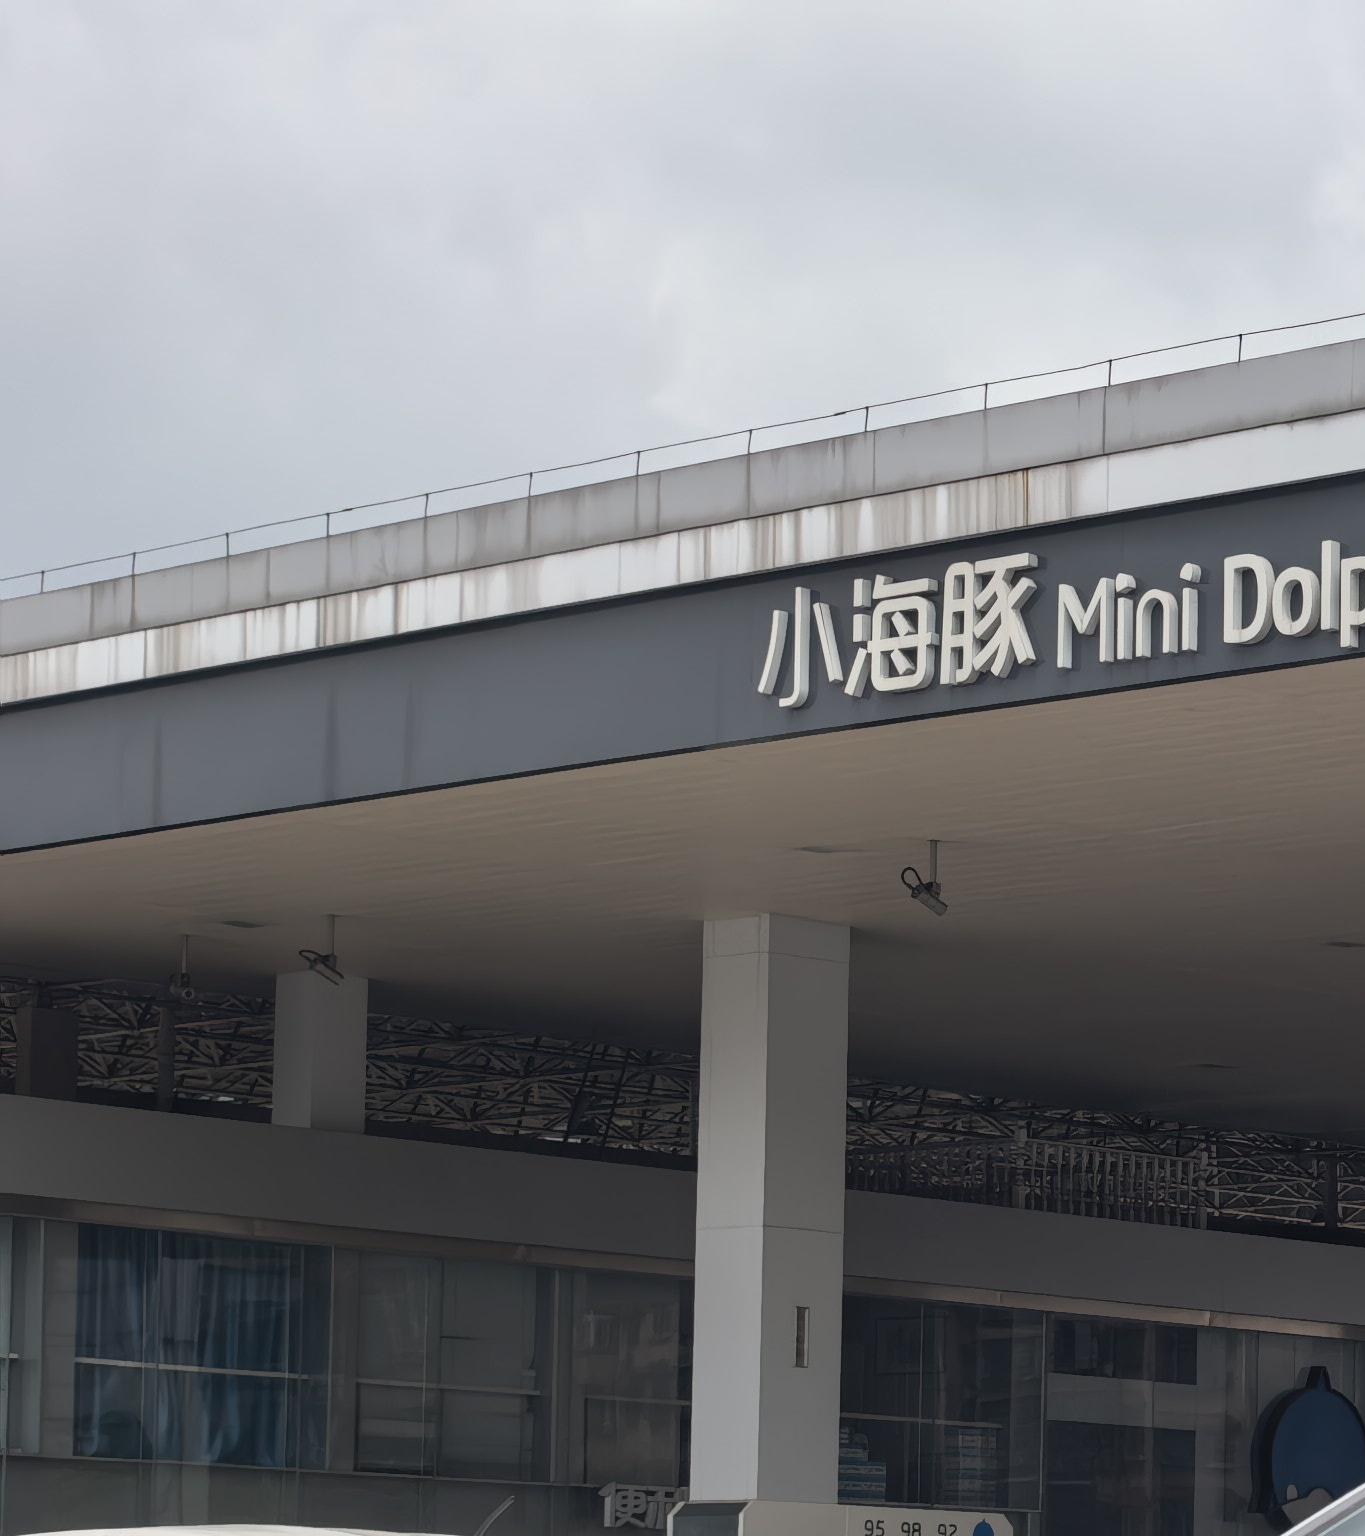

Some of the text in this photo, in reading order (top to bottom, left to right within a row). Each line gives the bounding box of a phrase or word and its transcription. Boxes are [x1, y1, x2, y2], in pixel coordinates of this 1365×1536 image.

[758, 552, 1038, 708] 小海豚
[1056, 562, 1201, 670] Mini
